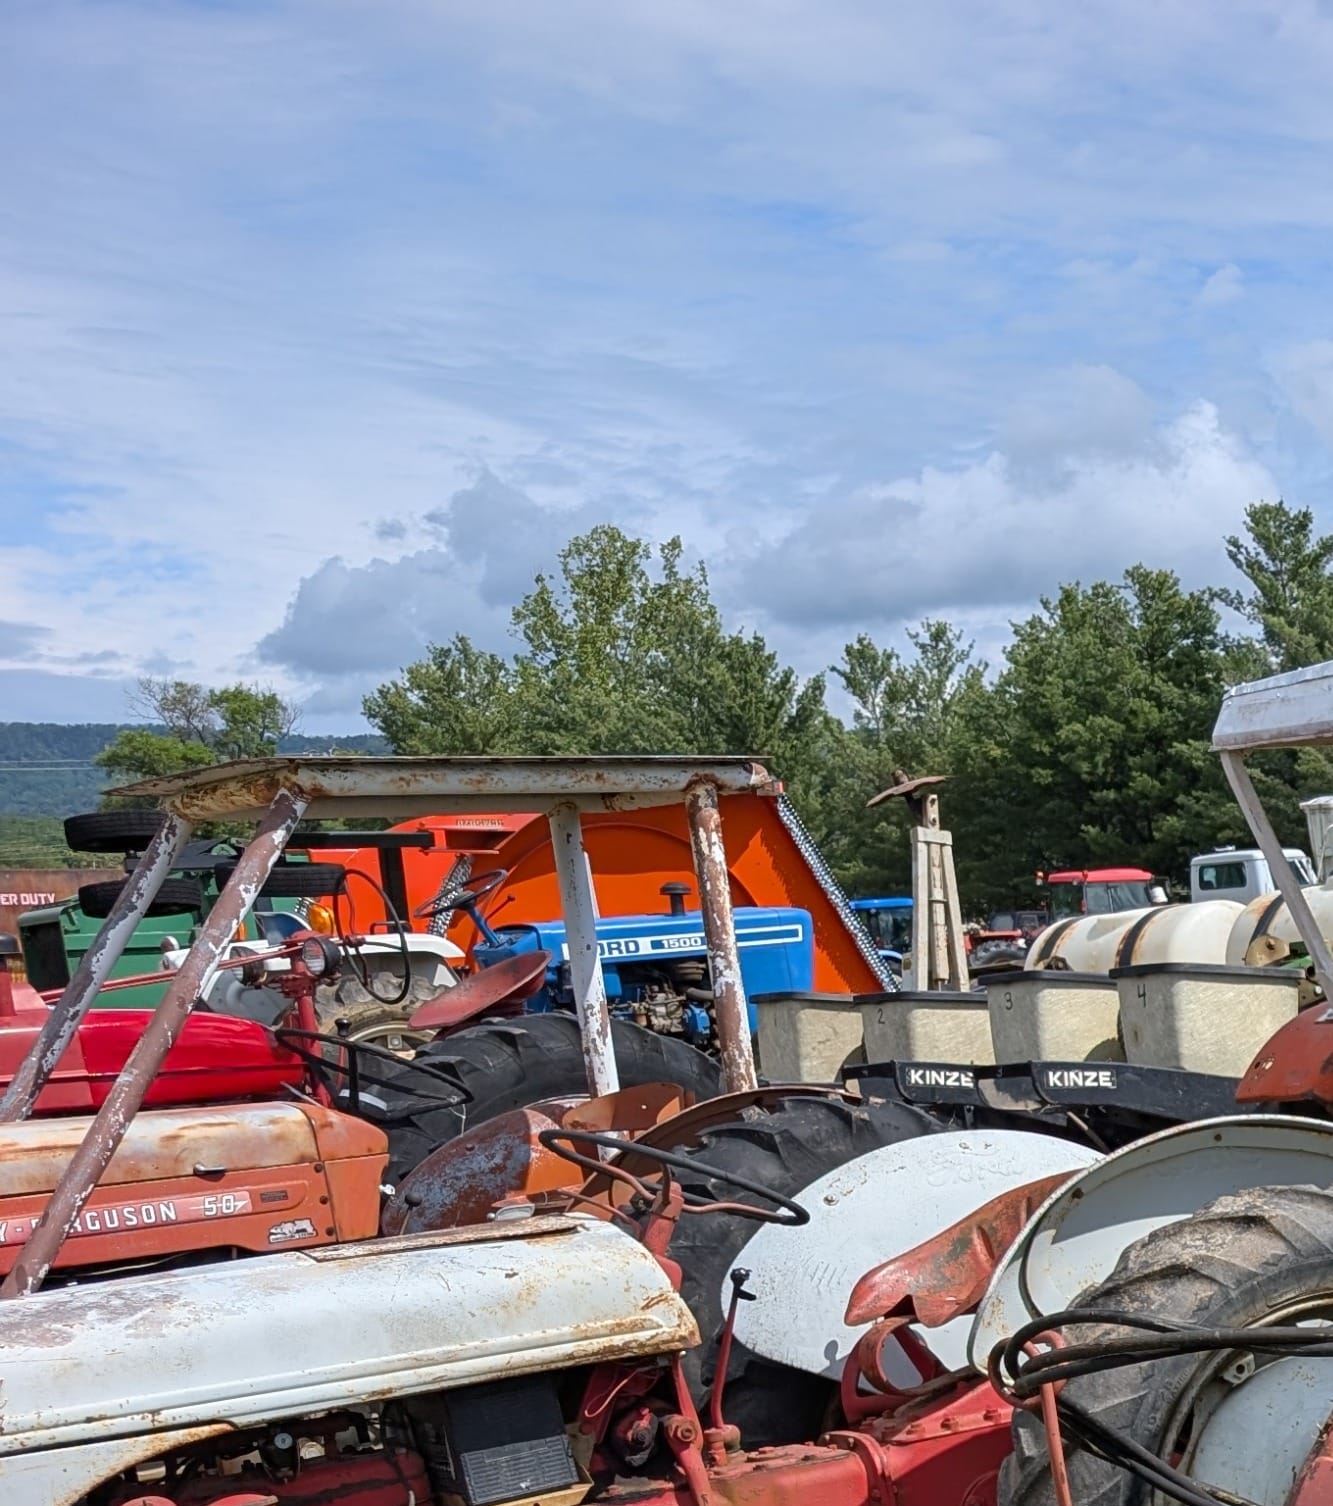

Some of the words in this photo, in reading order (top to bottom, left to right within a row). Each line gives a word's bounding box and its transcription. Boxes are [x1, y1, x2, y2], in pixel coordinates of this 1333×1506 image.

[20, 893, 55, 905] DUTY
[597, 939, 640, 957] RD
[661, 937, 702, 949] 1500
[1004, 991, 1014, 1011] 3
[1136, 983, 1147, 1009] 4
[876, 1007, 886, 1025] 2
[910, 1069, 974, 1088] KINZE
[1048, 1070, 1113, 1088] KINZE
[31, 1201, 177, 1233] RGUSON
[203, 1194, 236, 1217] 50
